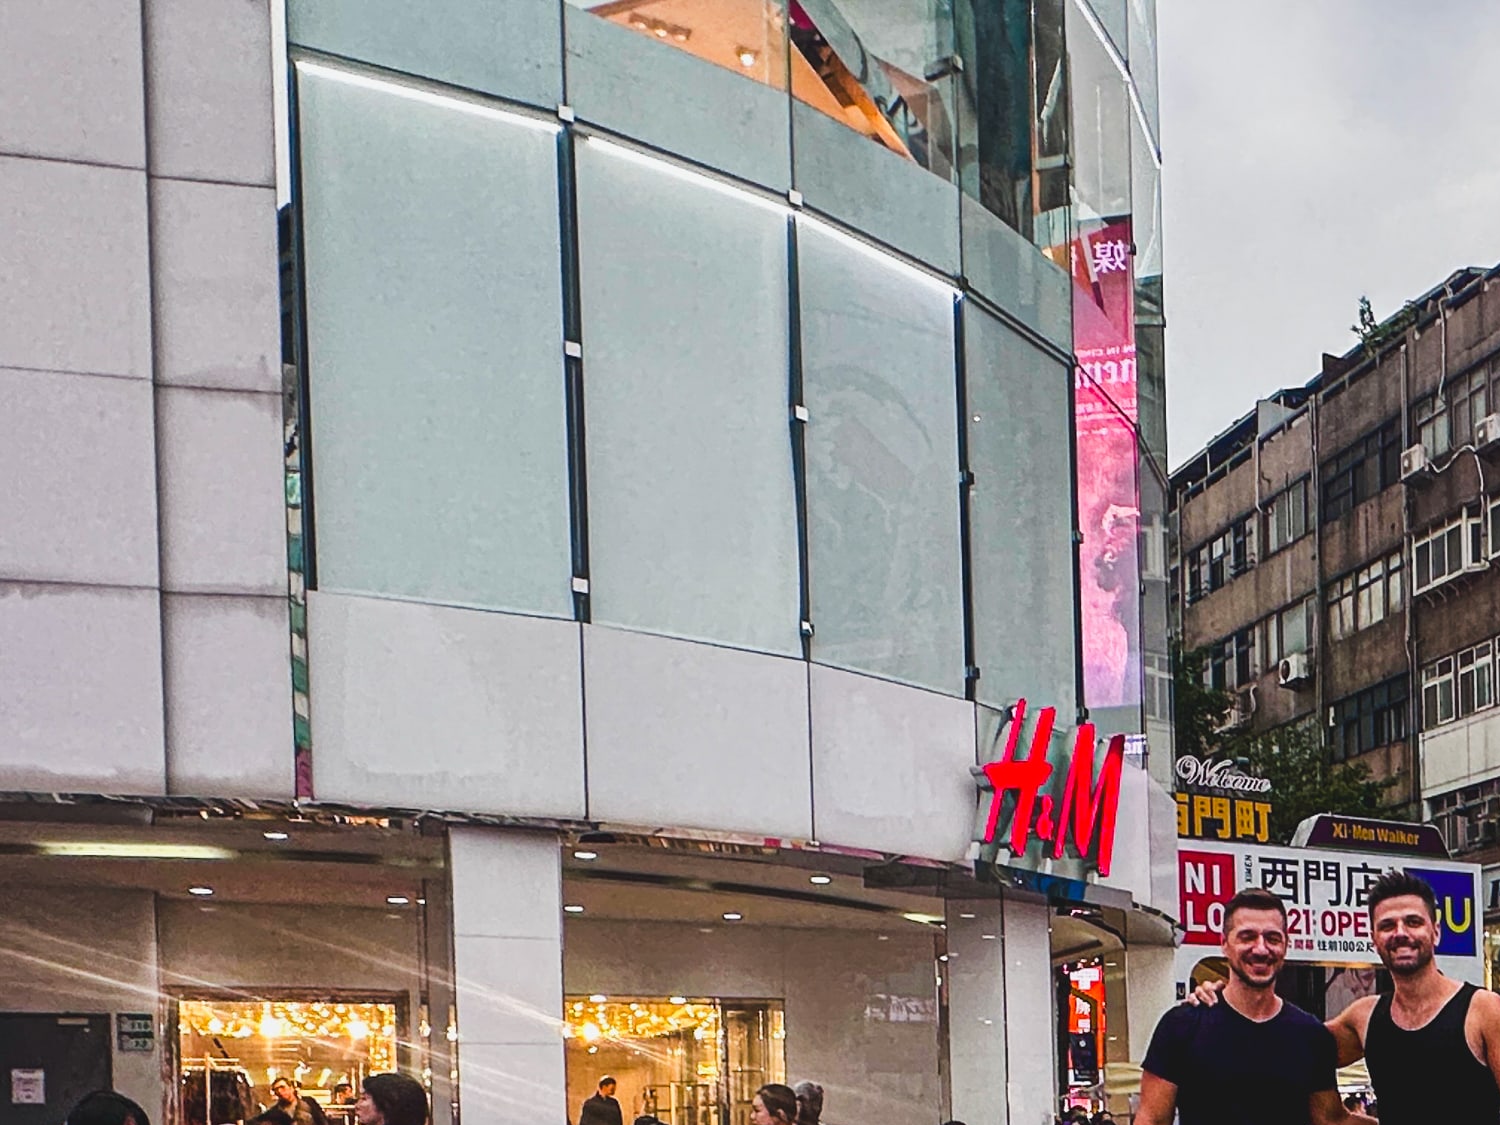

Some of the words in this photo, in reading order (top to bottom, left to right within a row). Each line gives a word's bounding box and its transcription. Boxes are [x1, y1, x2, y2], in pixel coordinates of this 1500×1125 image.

[982, 697, 1126, 878] H&M
[1175, 754, 1272, 793] Welcome
[1377, 828, 1420, 846] Walker
[1258, 856, 1382, 908] 西門店
[1320, 911, 1369, 938] OPE
